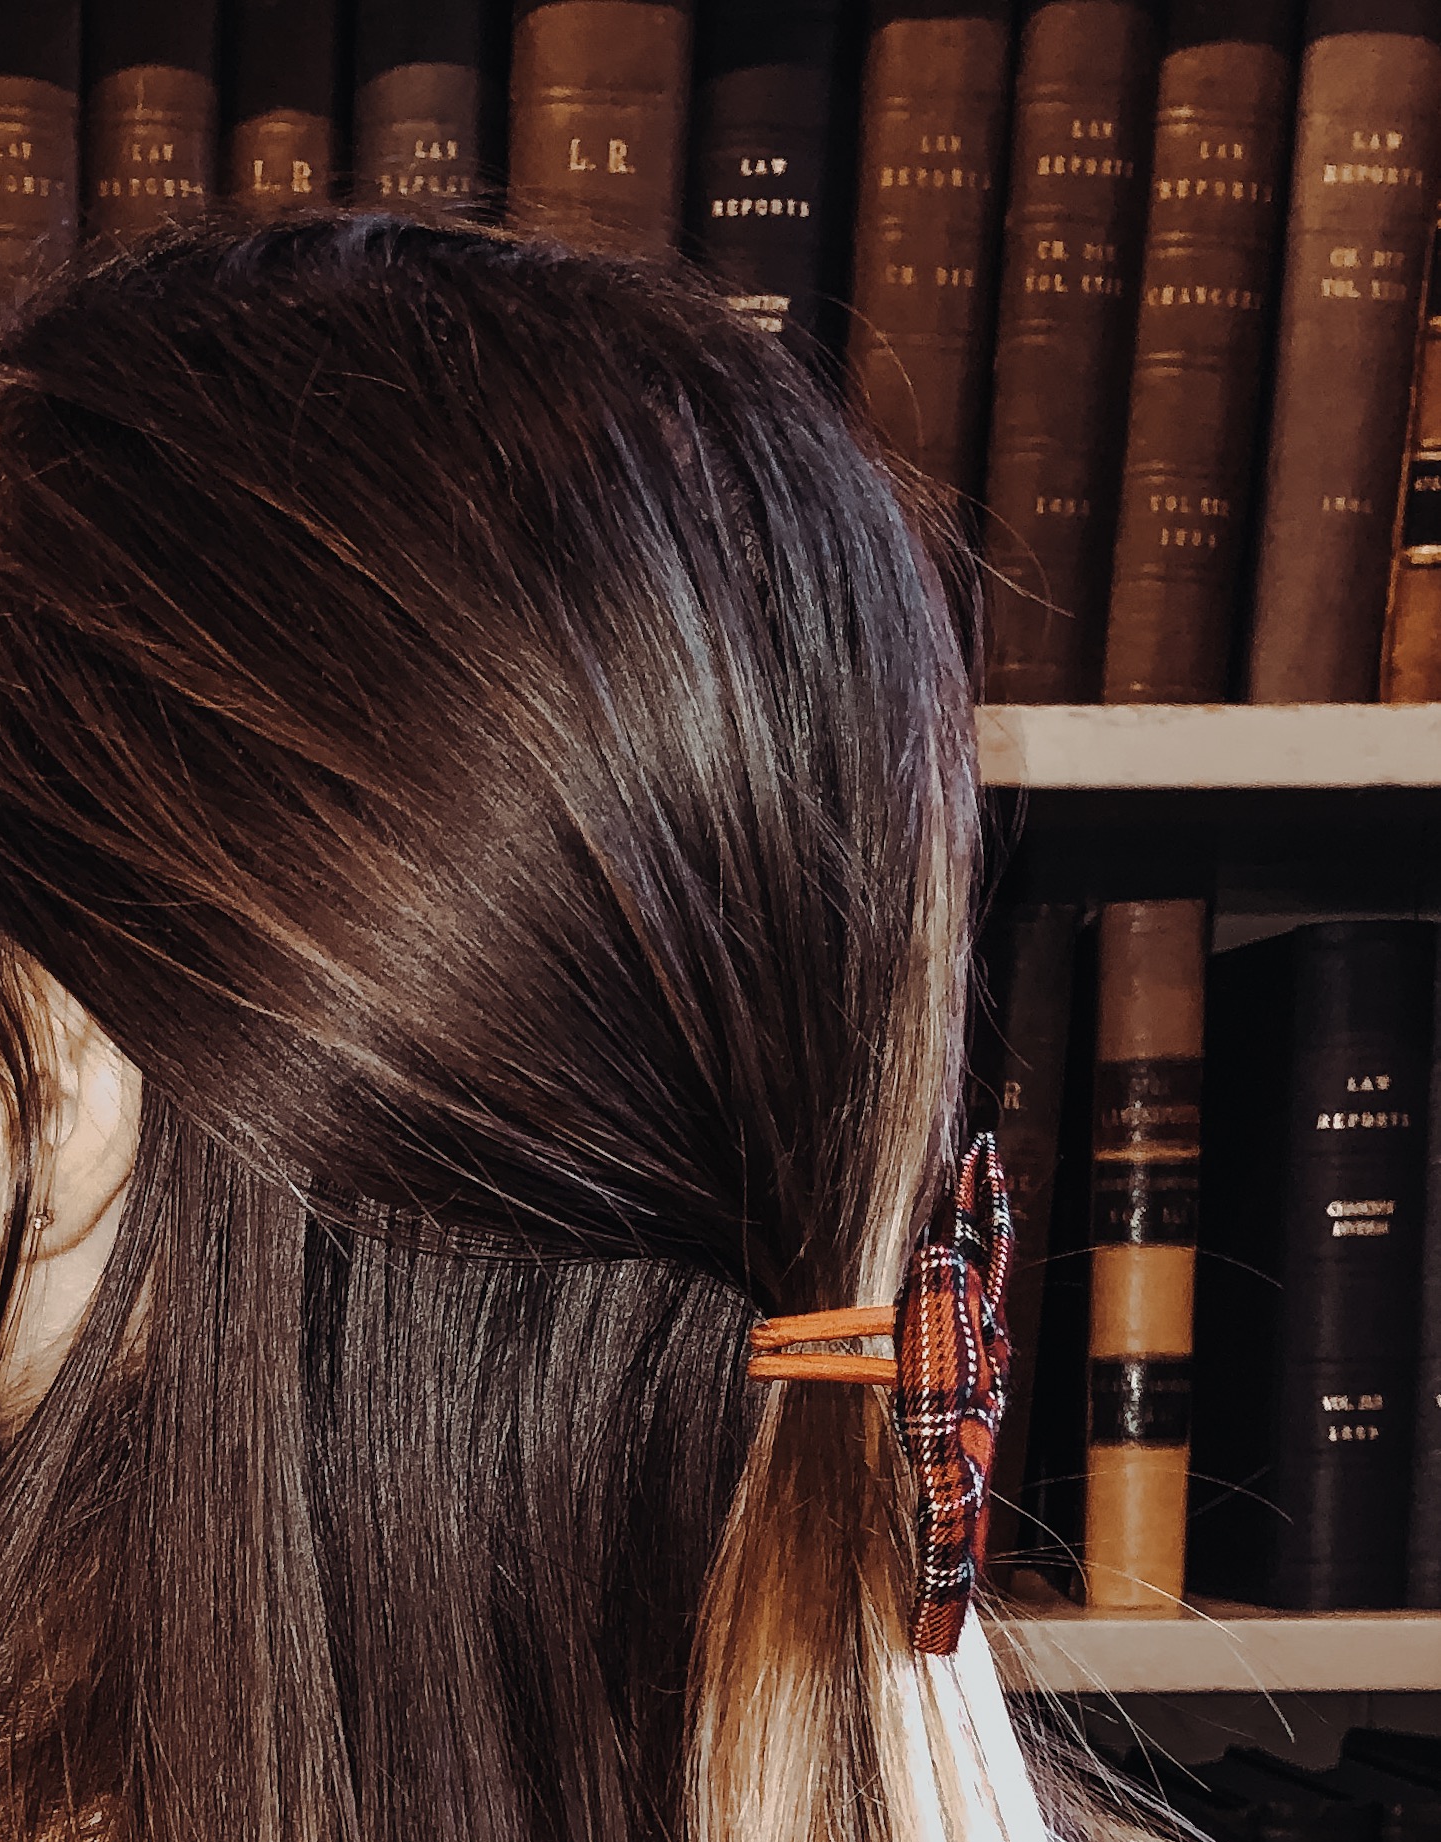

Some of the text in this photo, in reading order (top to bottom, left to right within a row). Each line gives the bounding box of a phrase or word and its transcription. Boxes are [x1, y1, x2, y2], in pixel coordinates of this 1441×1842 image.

[1072, 120, 1113, 139] LAW
[922, 135, 962, 153] LAW
[1352, 131, 1402, 150] LAW
[131, 143, 174, 161] LAW
[1199, 141, 1243, 160] LAW
[740, 158, 788, 176] LAW
[711, 199, 810, 218] REPORTS
[1346, 1074, 1391, 1092] LAW
[1317, 1112, 1410, 1130] REPORTS
